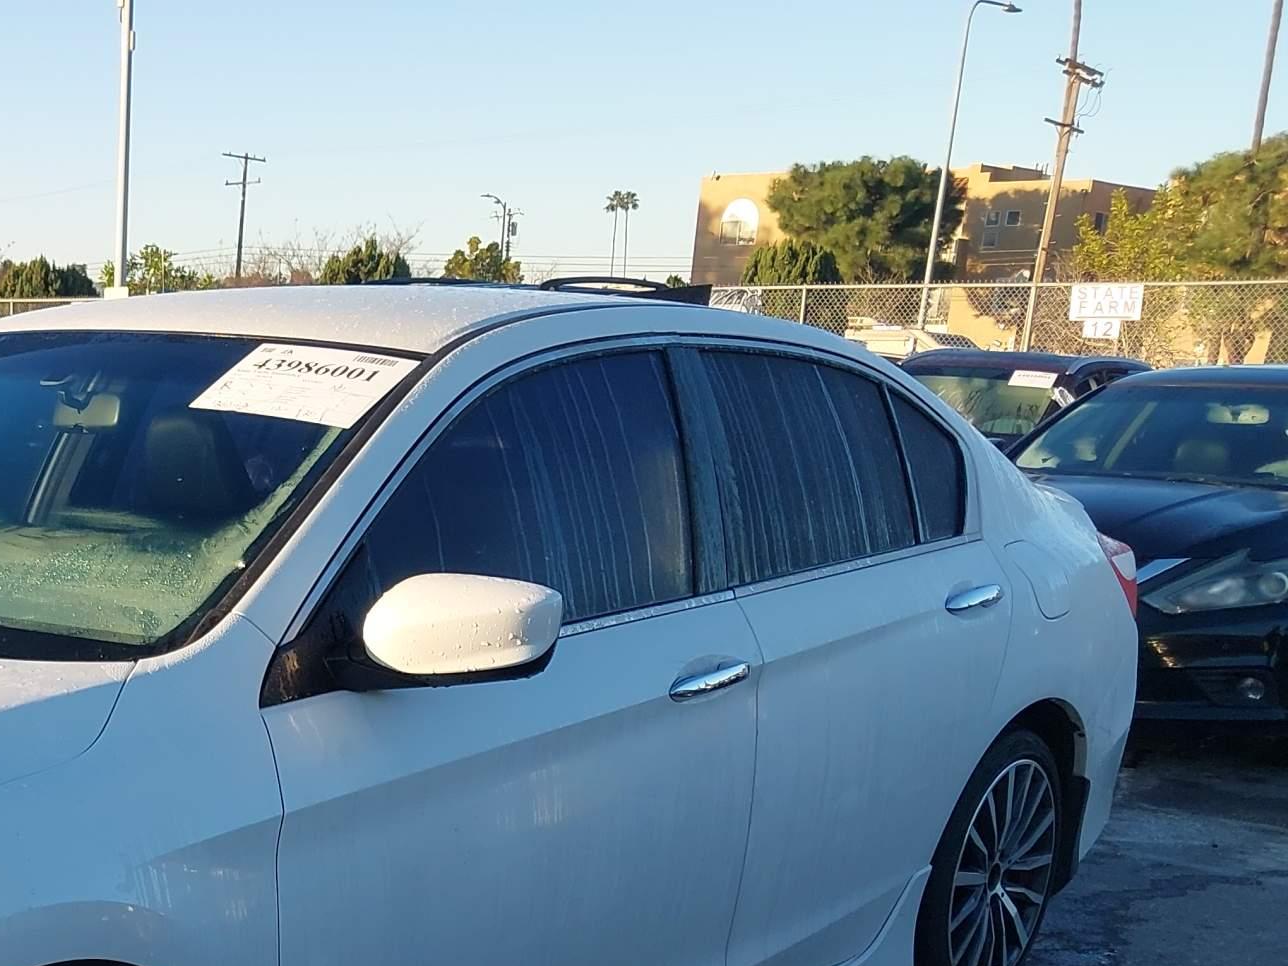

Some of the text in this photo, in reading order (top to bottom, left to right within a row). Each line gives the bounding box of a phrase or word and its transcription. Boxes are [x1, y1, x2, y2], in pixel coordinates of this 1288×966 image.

[1077, 286, 1139, 300] STATE
[1077, 300, 1137, 314] FARM
[1091, 321, 1113, 337] 12
[253, 357, 380, 382] 43986001
